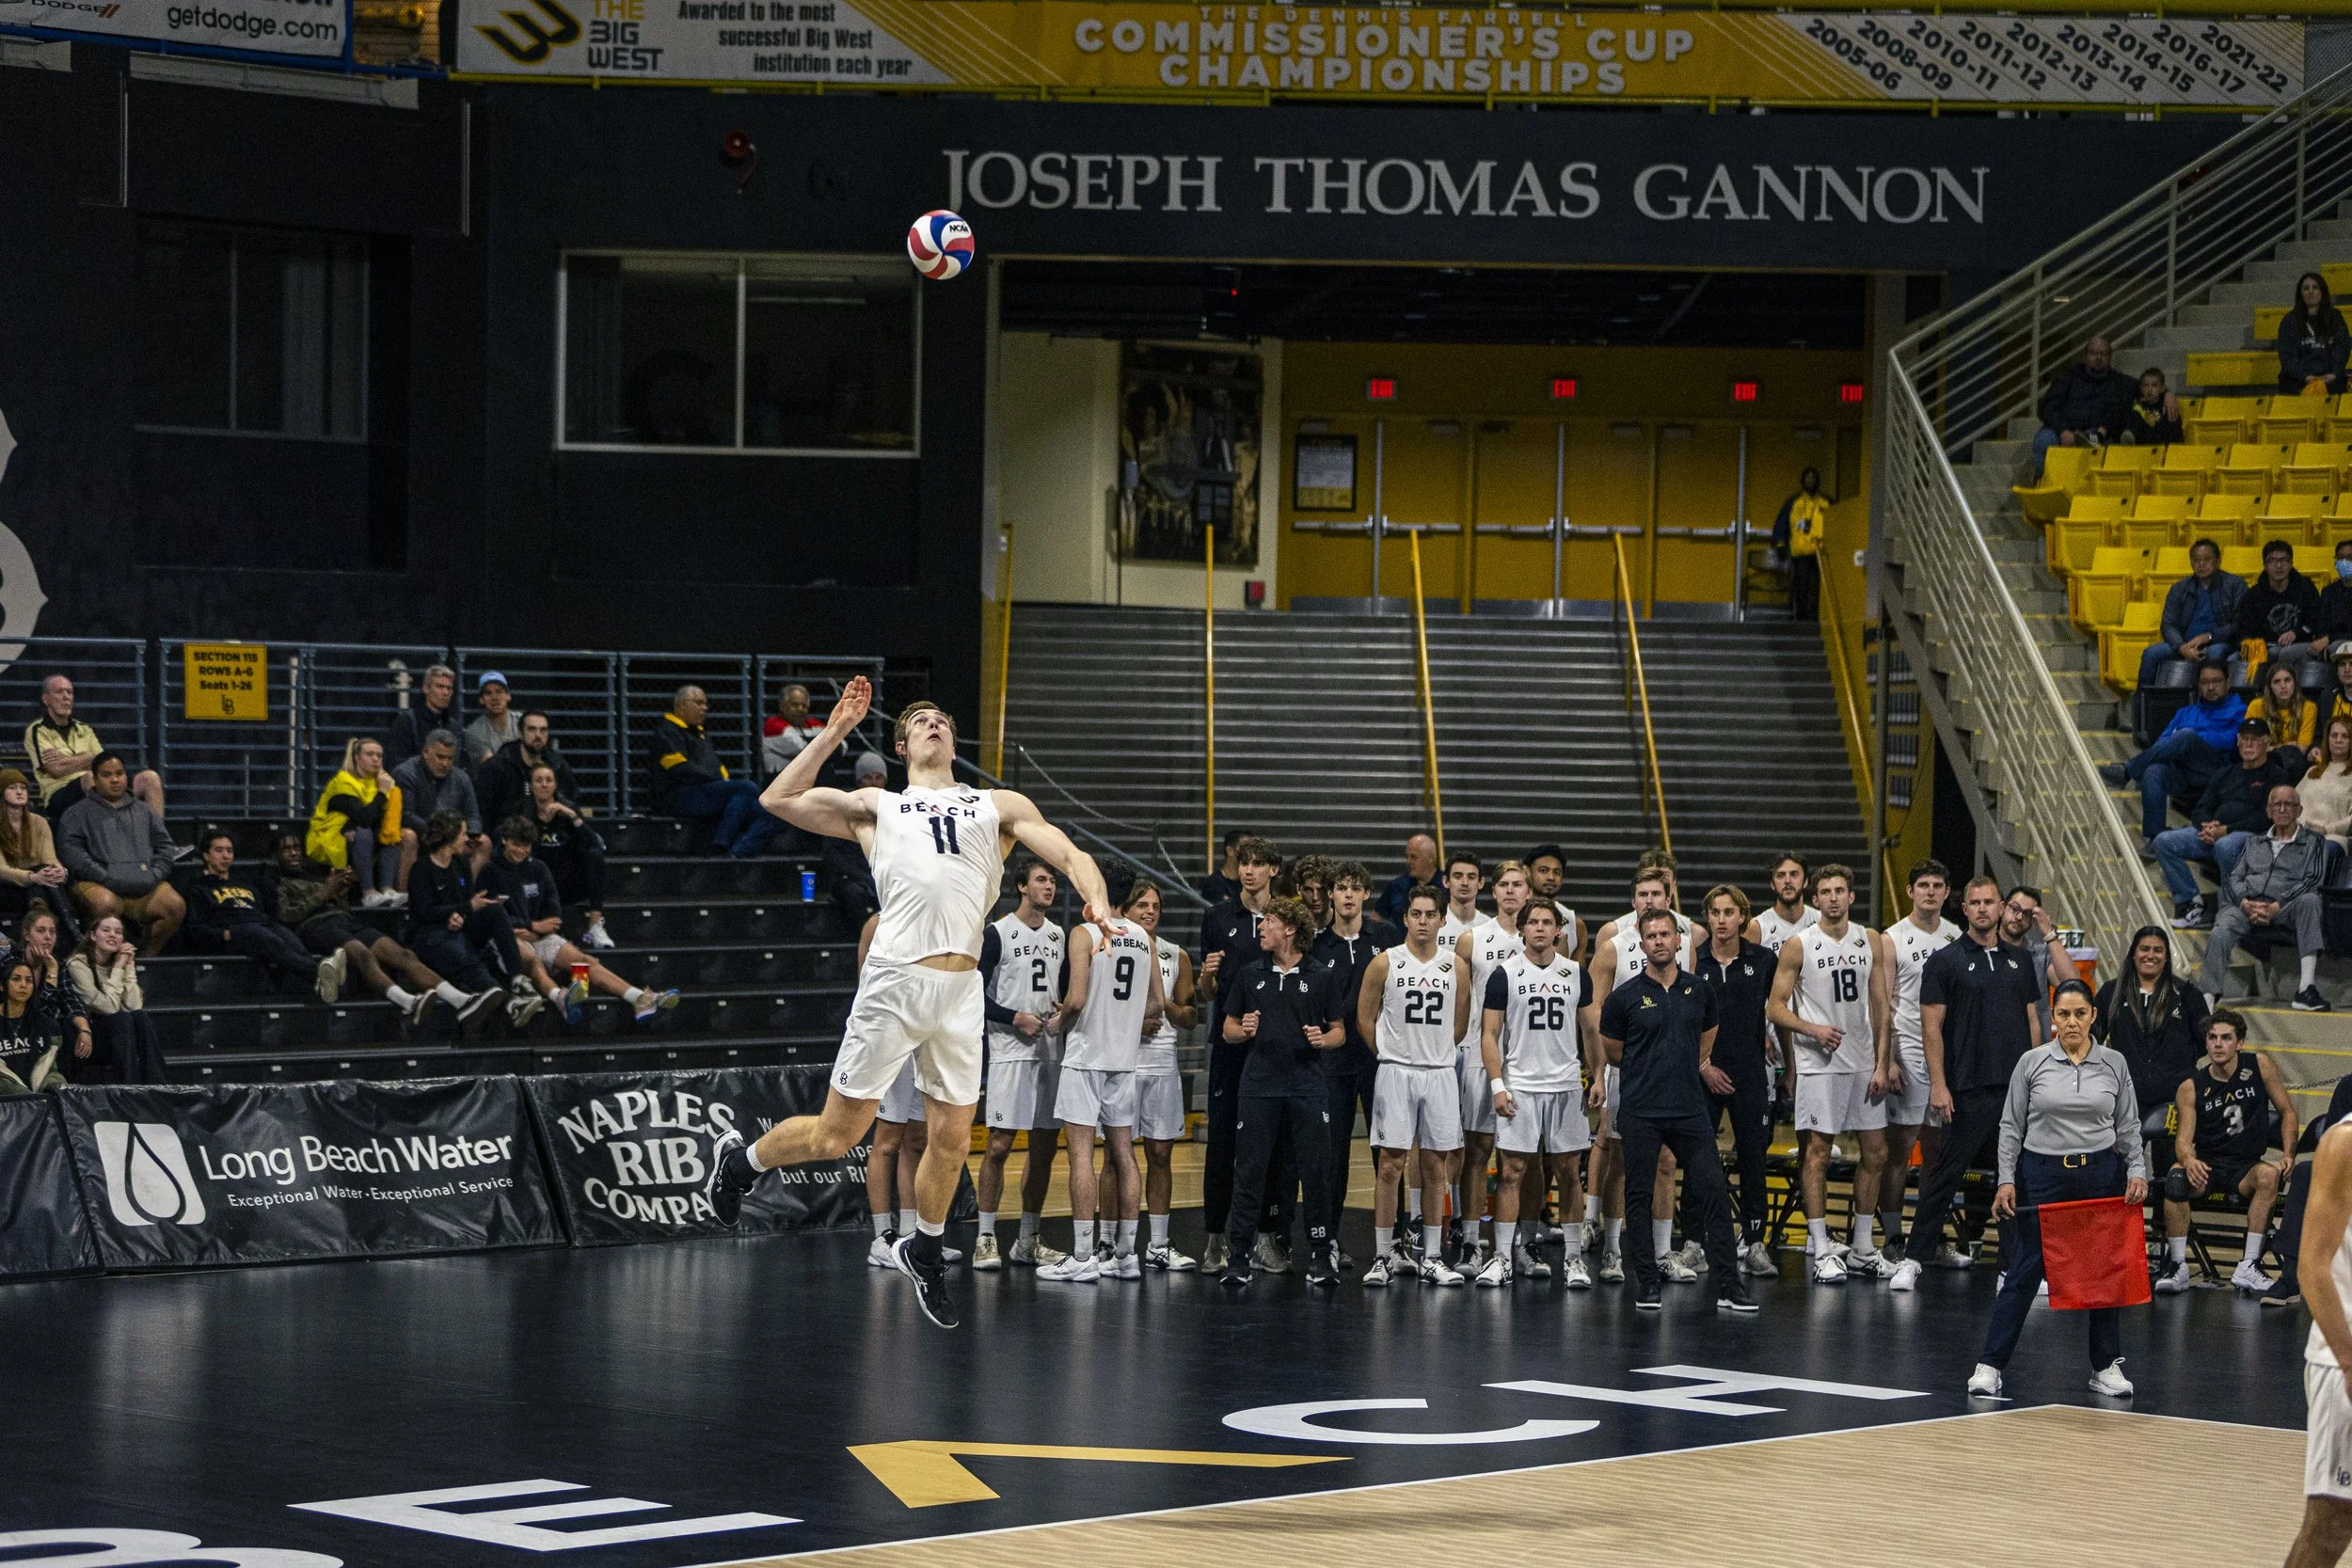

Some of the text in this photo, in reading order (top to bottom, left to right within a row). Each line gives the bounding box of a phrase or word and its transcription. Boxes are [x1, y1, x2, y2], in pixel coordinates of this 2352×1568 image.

[167, 6, 338, 41] getdodge.com
[595, 0, 644, 20] THE
[678, 0, 835, 23] Awarded to the most
[1200, 6, 1259, 21] THE
[1438, 10, 1587, 27] FARRELL
[590, 21, 640, 45] BIG
[719, 26, 873, 51] successful Big West
[1586, 28, 1694, 62] CUP
[588, 47, 664, 71] WEST
[754, 53, 913, 78] institution each year
[1805, 17, 1901, 91] 2005-06
[1856, 19, 1953, 92] 2008-09
[1907, 19, 2000, 91] 2010-11
[1959, 20, 2047, 92] 2011-12
[2007, 22, 2098, 93] 2012-13
[2057, 24, 2147, 93] 2013-14
[2103, 23, 2196, 93] 2014-15
[2153, 24, 2246, 95] 2016-17
[2201, 24, 2289, 93] 2021-22
[1159, 54, 1625, 94] CHAMPIONSHIPS
[942, 150, 1990, 224] JOSEPH THOMAS GANNON
[949, 225, 969, 233] NCAA
[194, 652, 258, 663] SECTION 115
[199, 666, 231, 676] ROWS
[199, 680, 253, 690] Seats 1-26
[900, 801, 976, 818] BEACH
[929, 816, 961, 854] 11
[1014, 944, 1058, 960] BEACH
[1123, 938, 1150, 955] BEACH
[1817, 955, 1867, 969] BEACH
[1031, 958, 1048, 992] 2
[1113, 956, 1135, 1001] 9
[1397, 976, 1450, 990] BEACH
[1518, 983, 1571, 995] BEACH
[1831, 968, 1859, 1004] 18
[1405, 990, 1444, 1025] 22
[1528, 996, 1565, 1030] 26
[2204, 1086, 2256, 1112] BEACH
[558, 1088, 735, 1154] NAPLES
[2223, 1104, 2245, 1136] 3
[199, 1134, 513, 1185] Long Beach Water
[607, 1136, 706, 1186] RIB
[779, 1167, 810, 1184] but
[815, 1169, 842, 1183] our
[227, 1177, 514, 1210] Exceptional Water Exceptional Service
[584, 1178, 716, 1225] COMPA
[1311, 1227, 1326, 1238] 28
[1749, 1219, 1762, 1231] 17
